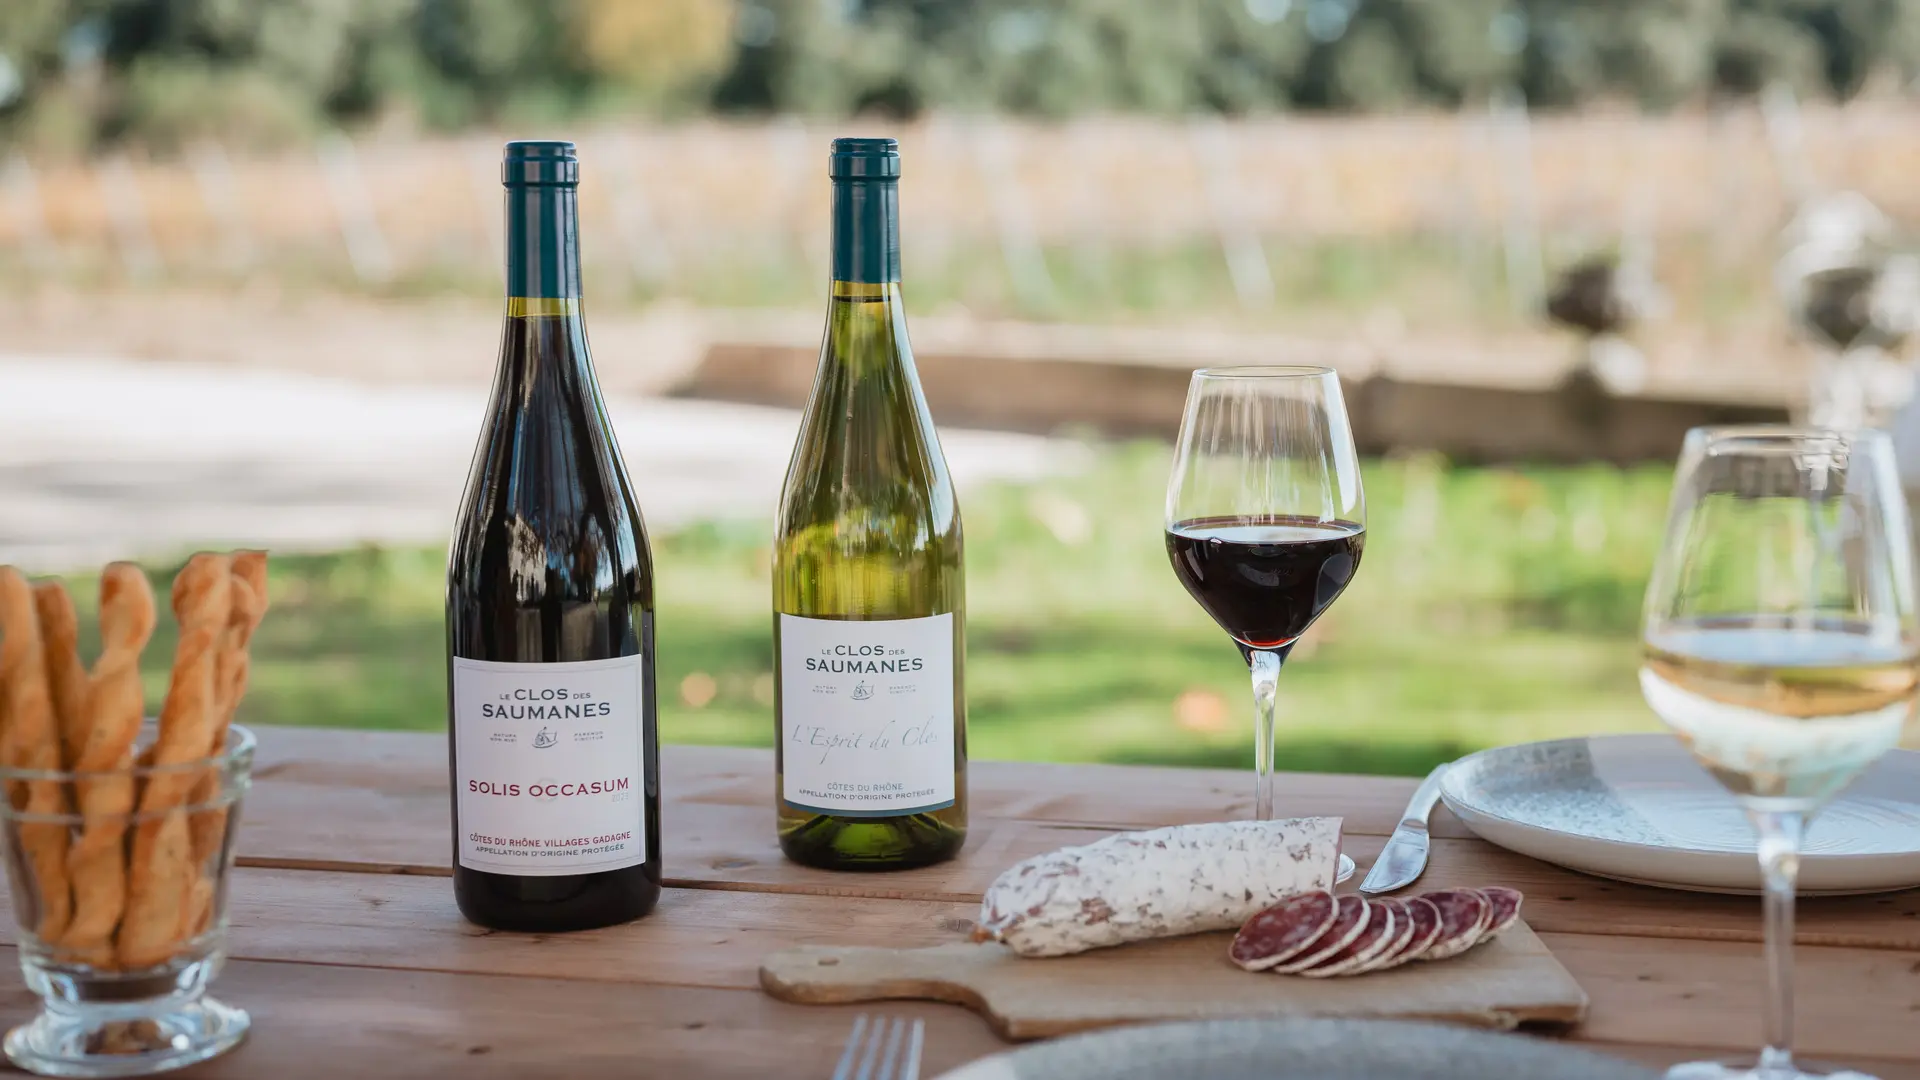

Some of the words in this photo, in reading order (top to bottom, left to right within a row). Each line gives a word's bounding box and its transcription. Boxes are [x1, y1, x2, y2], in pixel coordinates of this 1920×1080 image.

[821, 648, 832, 656] LE
[834, 645, 885, 656] CLOS
[806, 658, 923, 674] SAUMANES
[514, 688, 569, 701] CLOS
[573, 692, 591, 700] DES
[482, 702, 611, 720] SAUMANES
[869, 720, 896, 750] du
[469, 779, 520, 796] SOLIS
[528, 777, 629, 797] OCCASUM
[827, 782, 855, 791] CÔTES
[857, 783, 870, 791] DU
[873, 782, 903, 791] RHÔNE
[799, 788, 847, 800] APPELLATION
[469, 832, 493, 844] CÔTES
[494, 837, 507, 846] DU
[509, 837, 541, 847] RHÔNE
[544, 838, 590, 847] VILLAGES
[592, 831, 631, 844] GADAGNE
[475, 846, 528, 857] APPELLATION
[531, 849, 579, 857] D'ORIGINE
